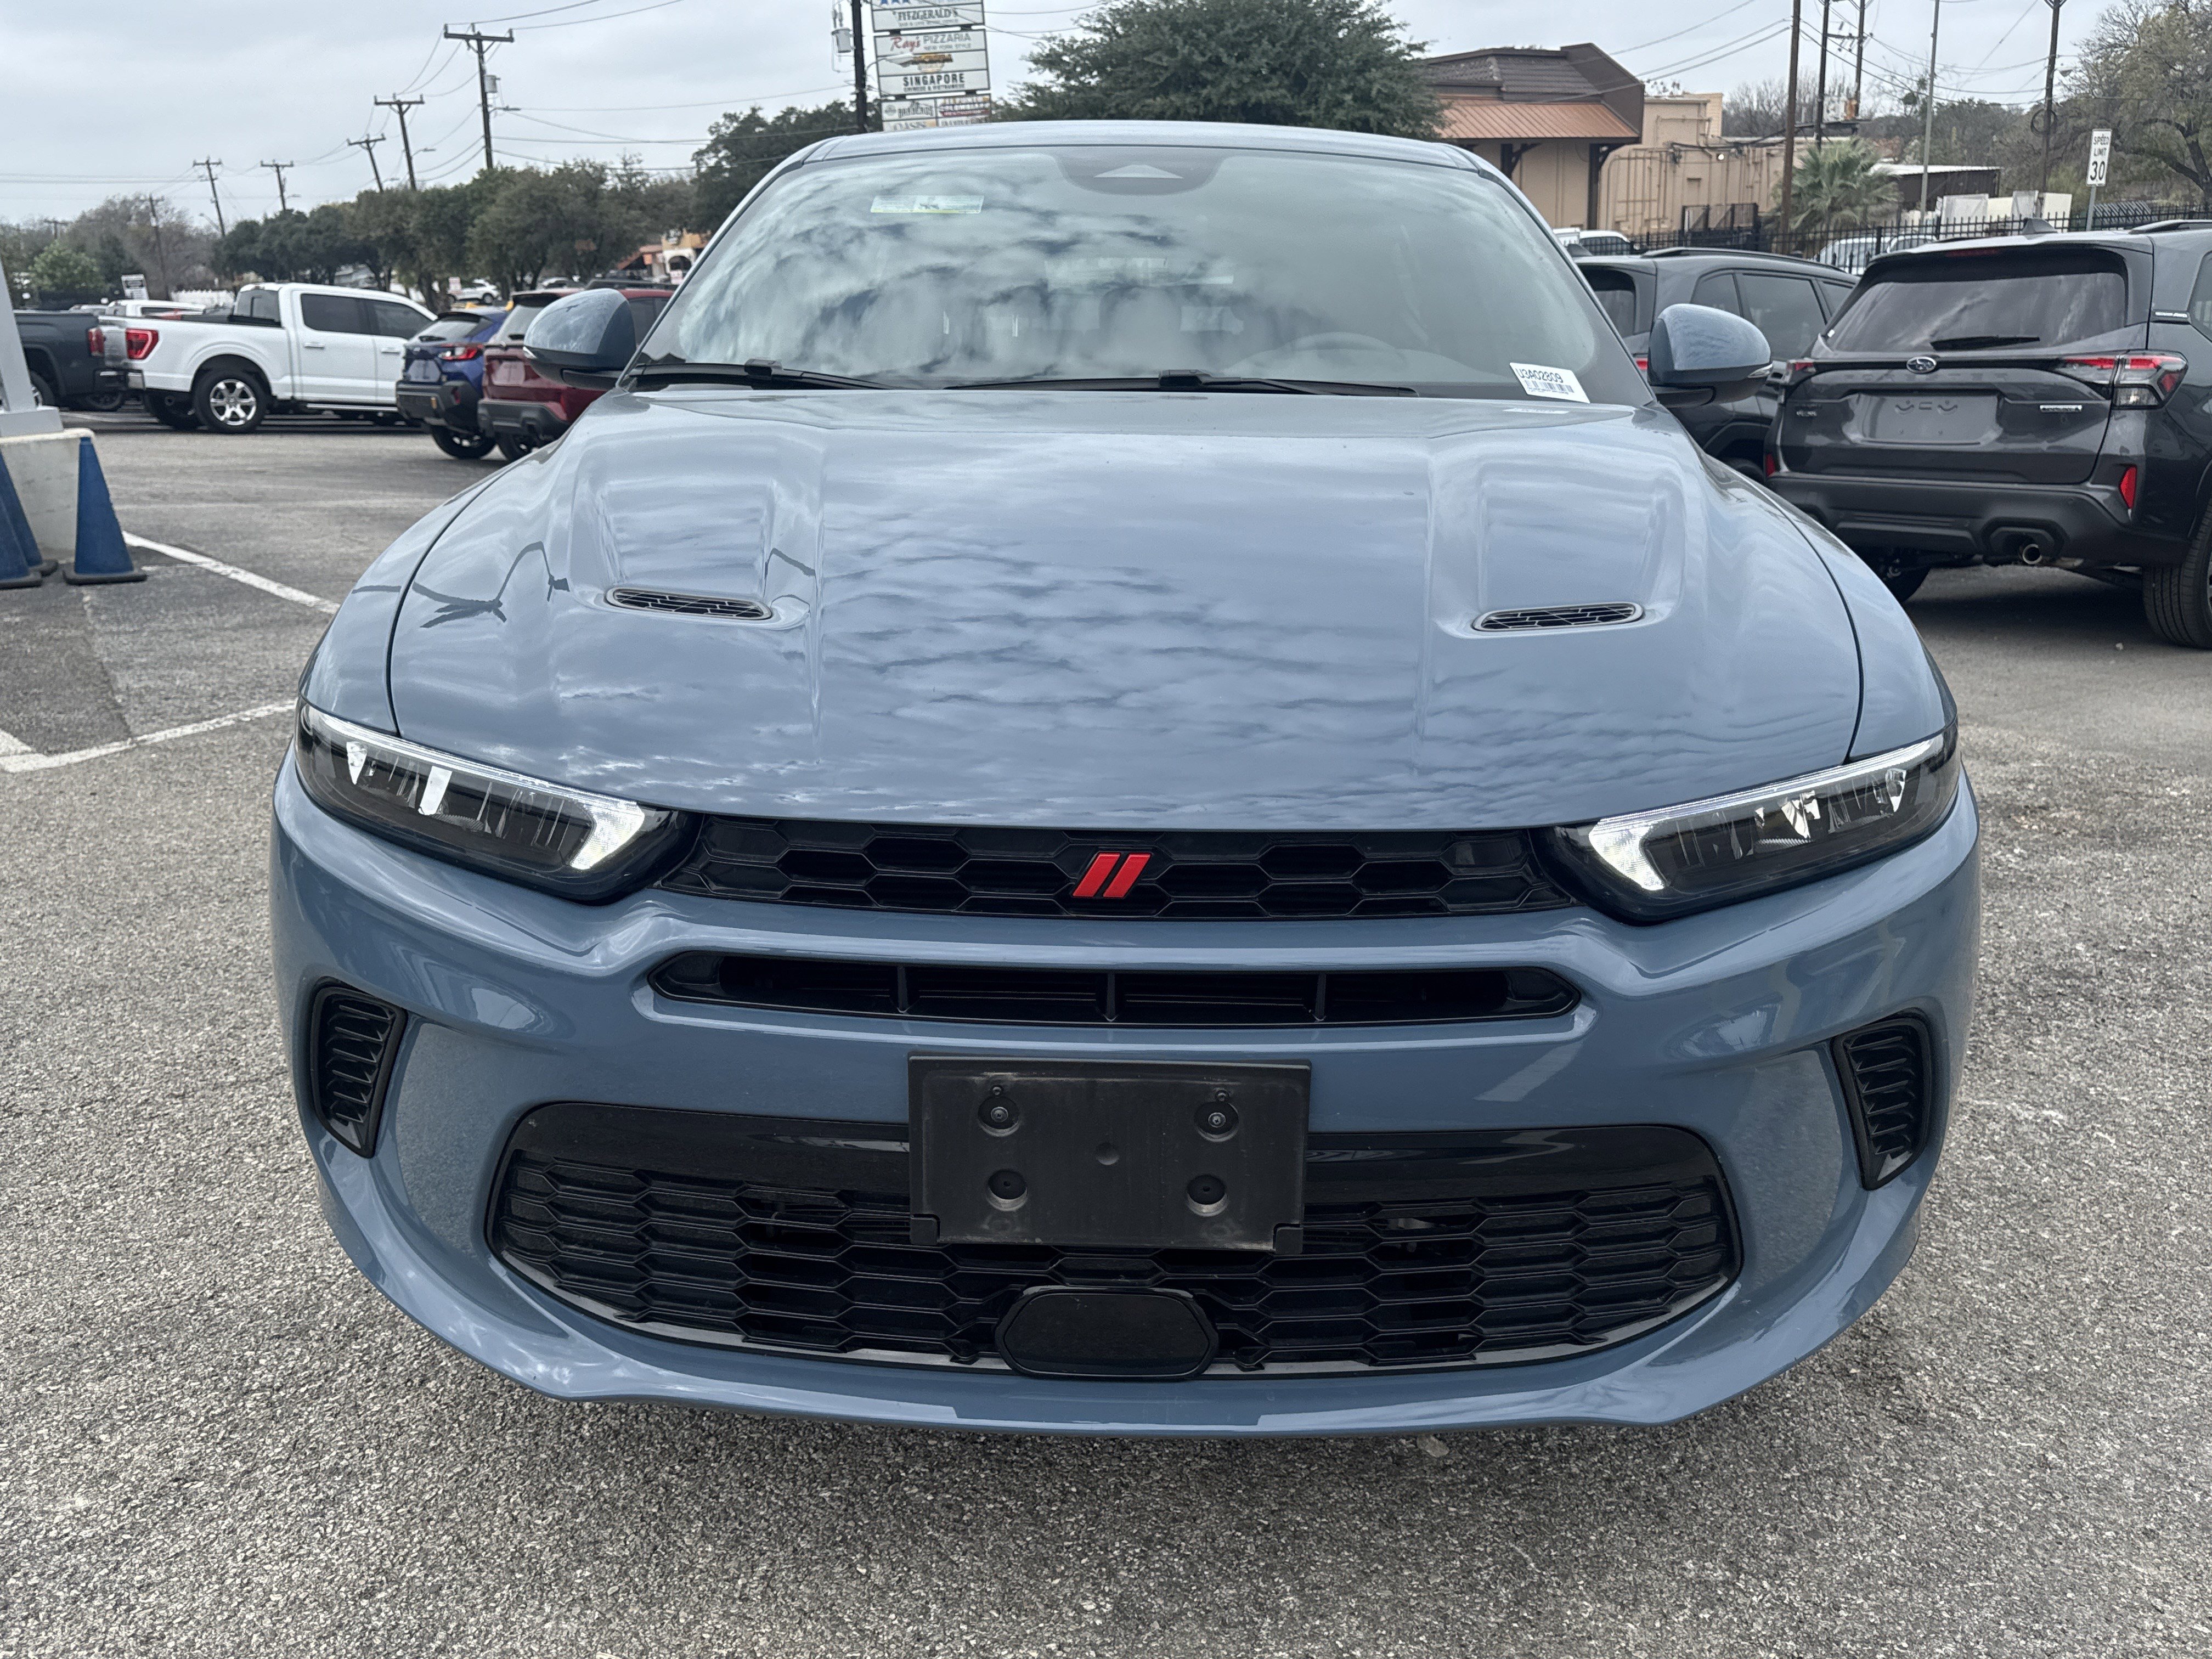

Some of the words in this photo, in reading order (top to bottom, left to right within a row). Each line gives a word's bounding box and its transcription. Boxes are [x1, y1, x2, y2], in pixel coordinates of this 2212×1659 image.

[923, 33, 971, 44] PIZZARIA
[903, 73, 966, 87] SINGAPORE
[2094, 136, 2109, 145] SPEED
[2094, 147, 2107, 157] LIMIT
[2090, 160, 2106, 181] 30
